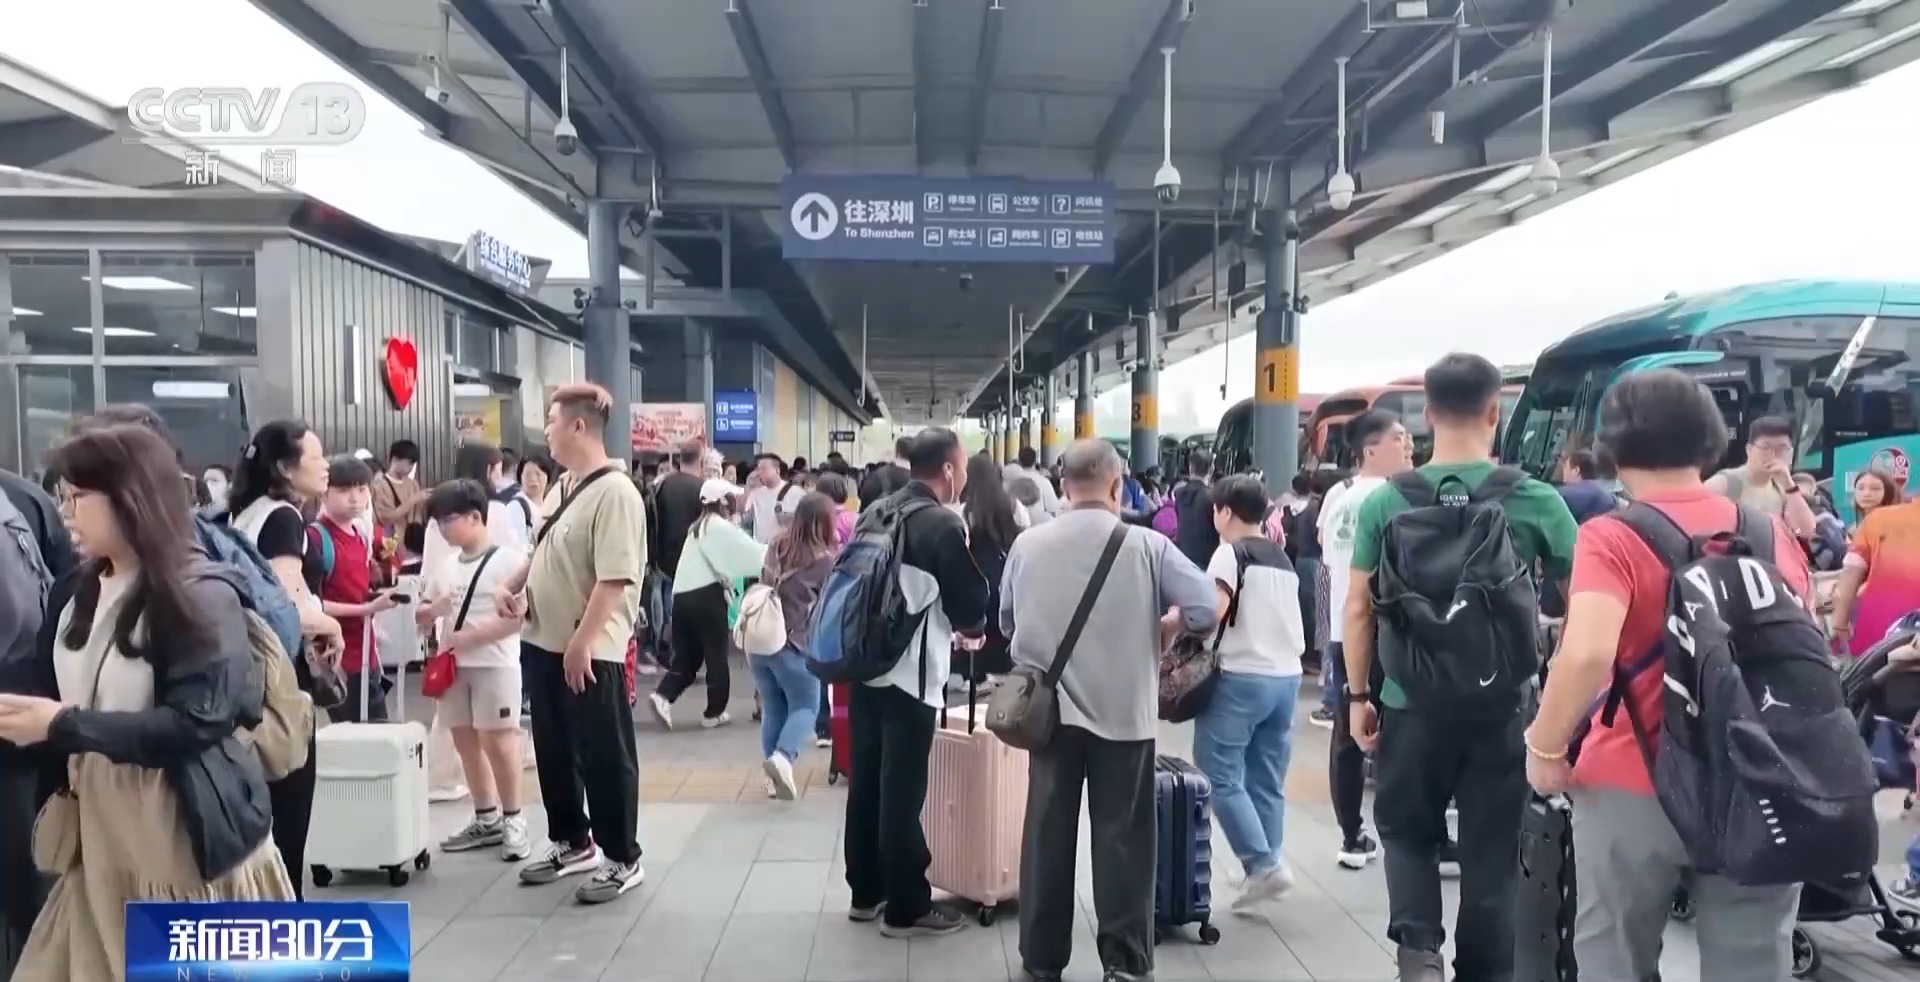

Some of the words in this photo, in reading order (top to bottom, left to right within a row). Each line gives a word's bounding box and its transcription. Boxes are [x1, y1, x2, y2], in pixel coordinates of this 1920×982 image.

[844, 199, 914, 225] 往深圳
[844, 226, 858, 238] To
[859, 226, 914, 240] Shenzhen
[1263, 362, 1276, 393] 1
